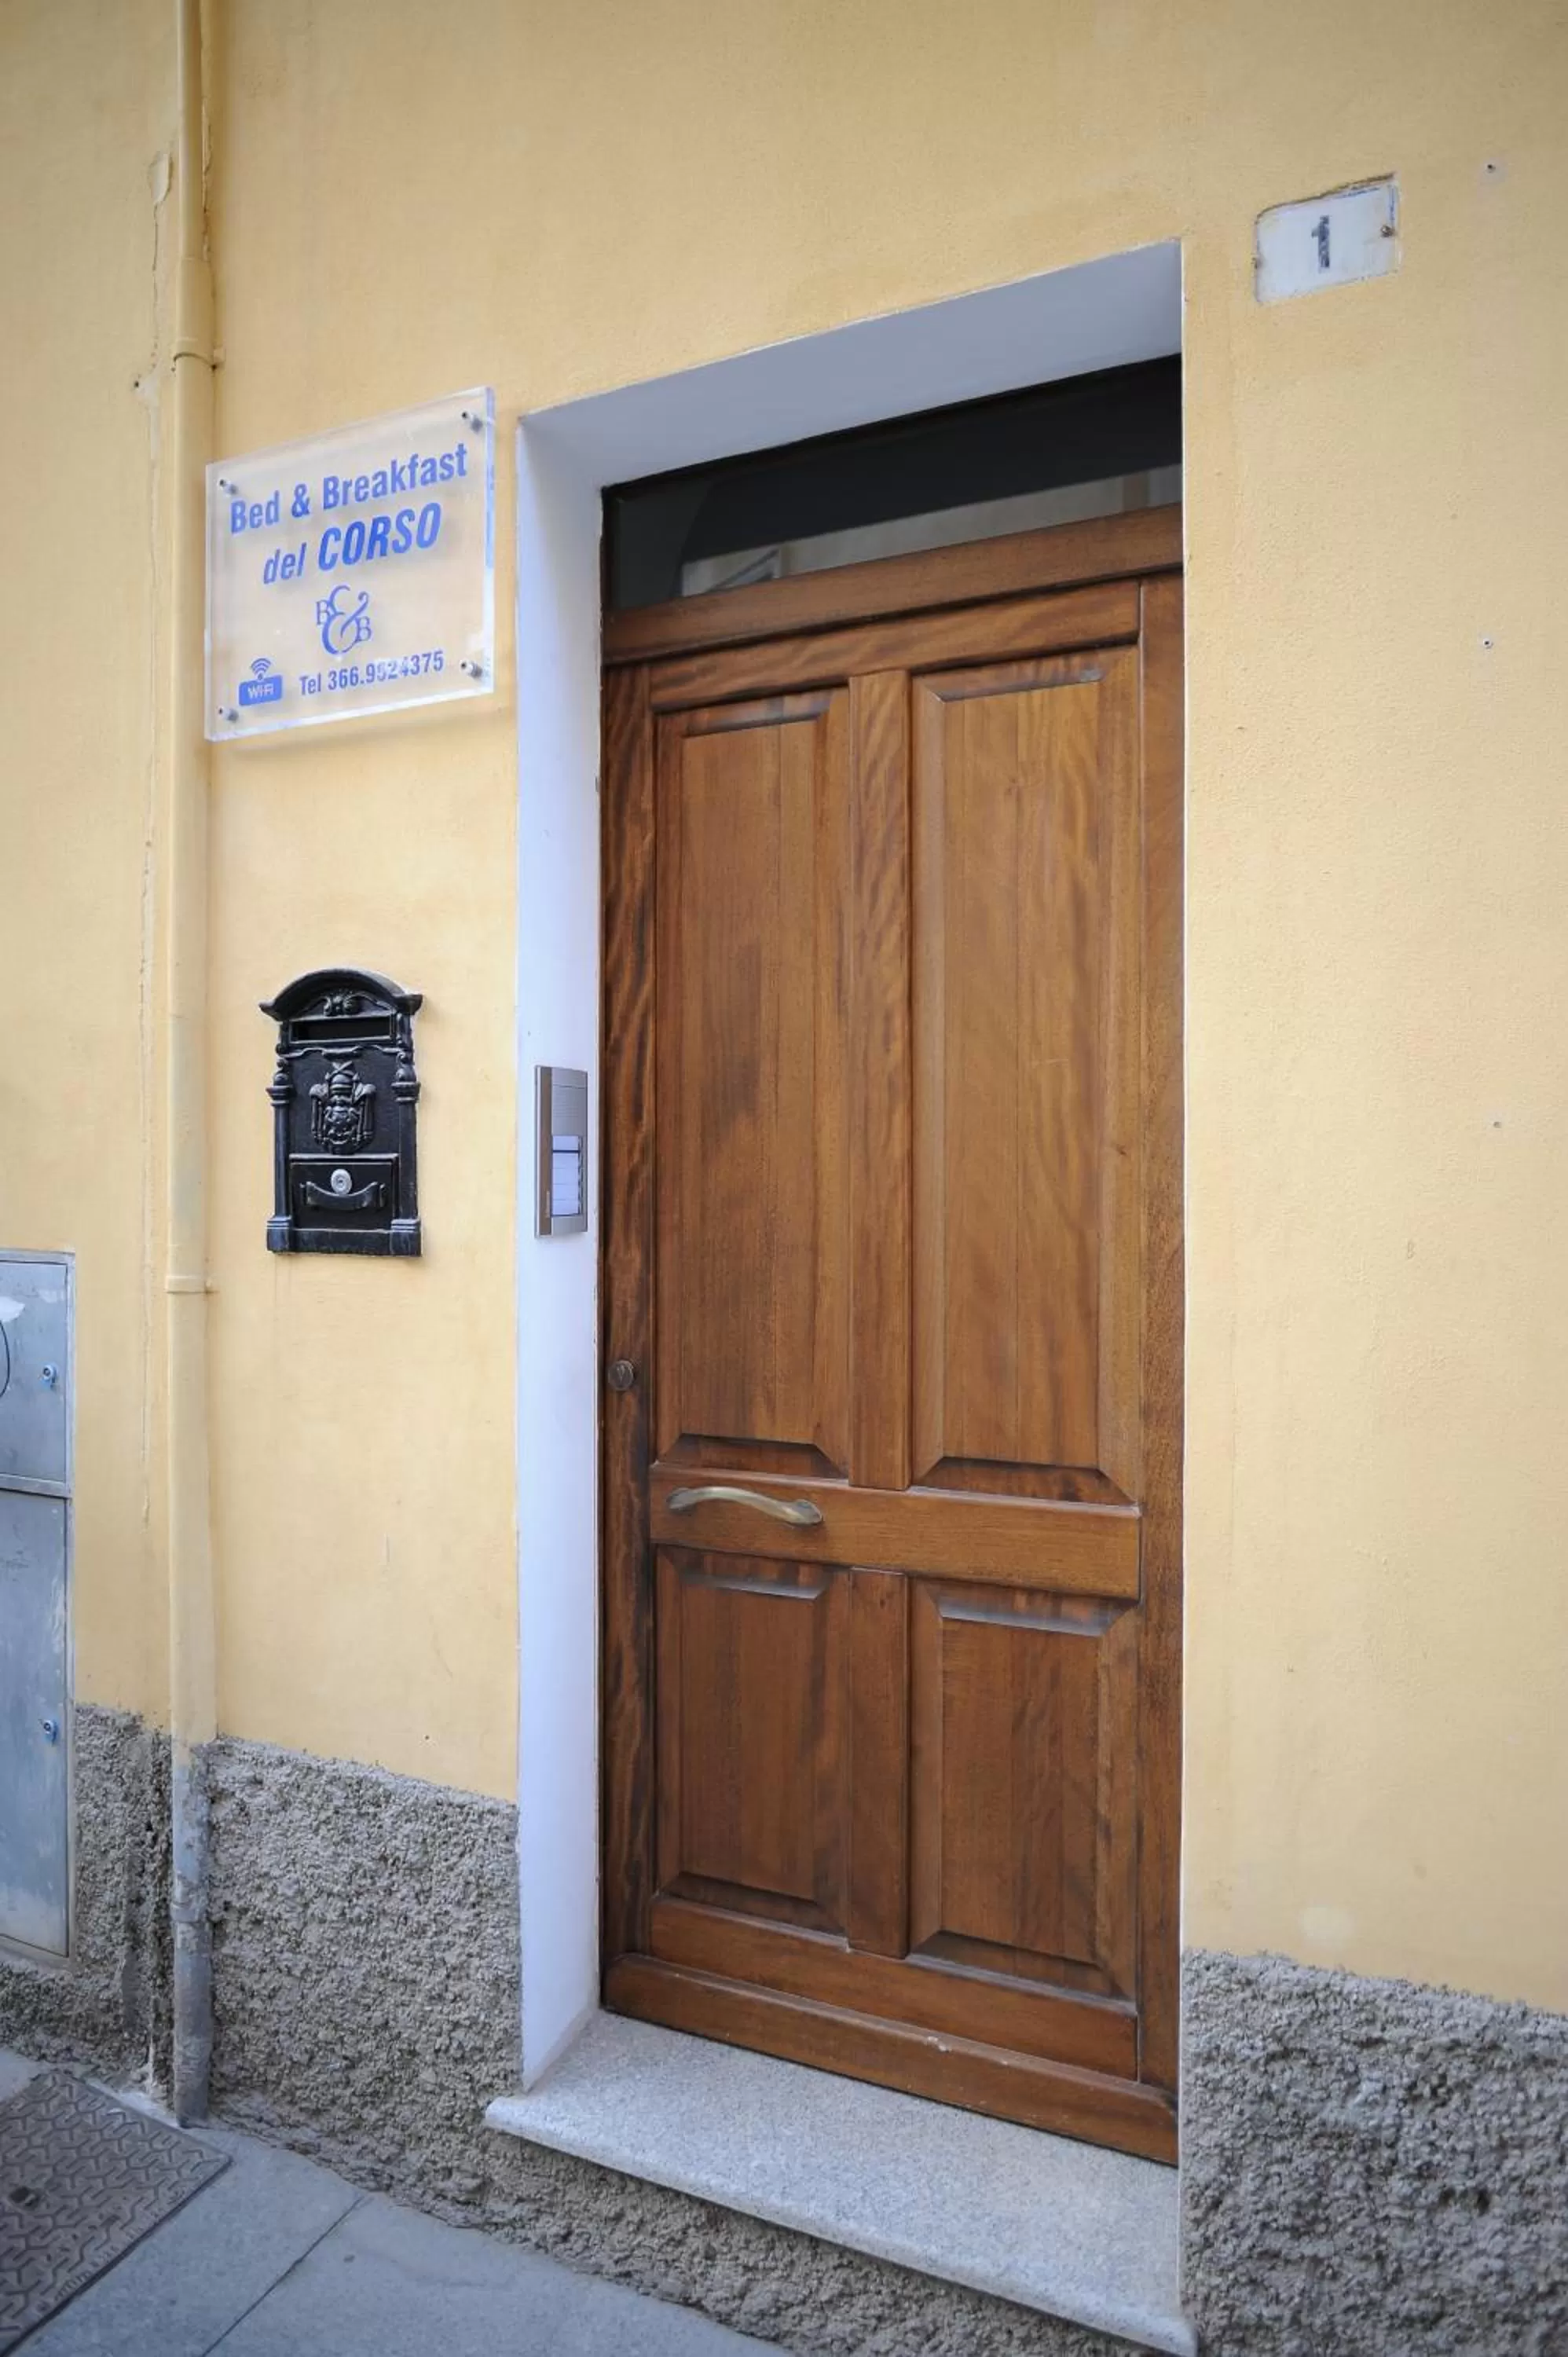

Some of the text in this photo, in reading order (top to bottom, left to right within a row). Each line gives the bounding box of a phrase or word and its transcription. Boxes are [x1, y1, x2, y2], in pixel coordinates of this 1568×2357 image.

[1311, 214, 1330, 268] 1
[230, 443, 467, 533] Bed & Breakfast
[263, 502, 441, 584] del CORSO
[299, 673, 321, 696] Tel
